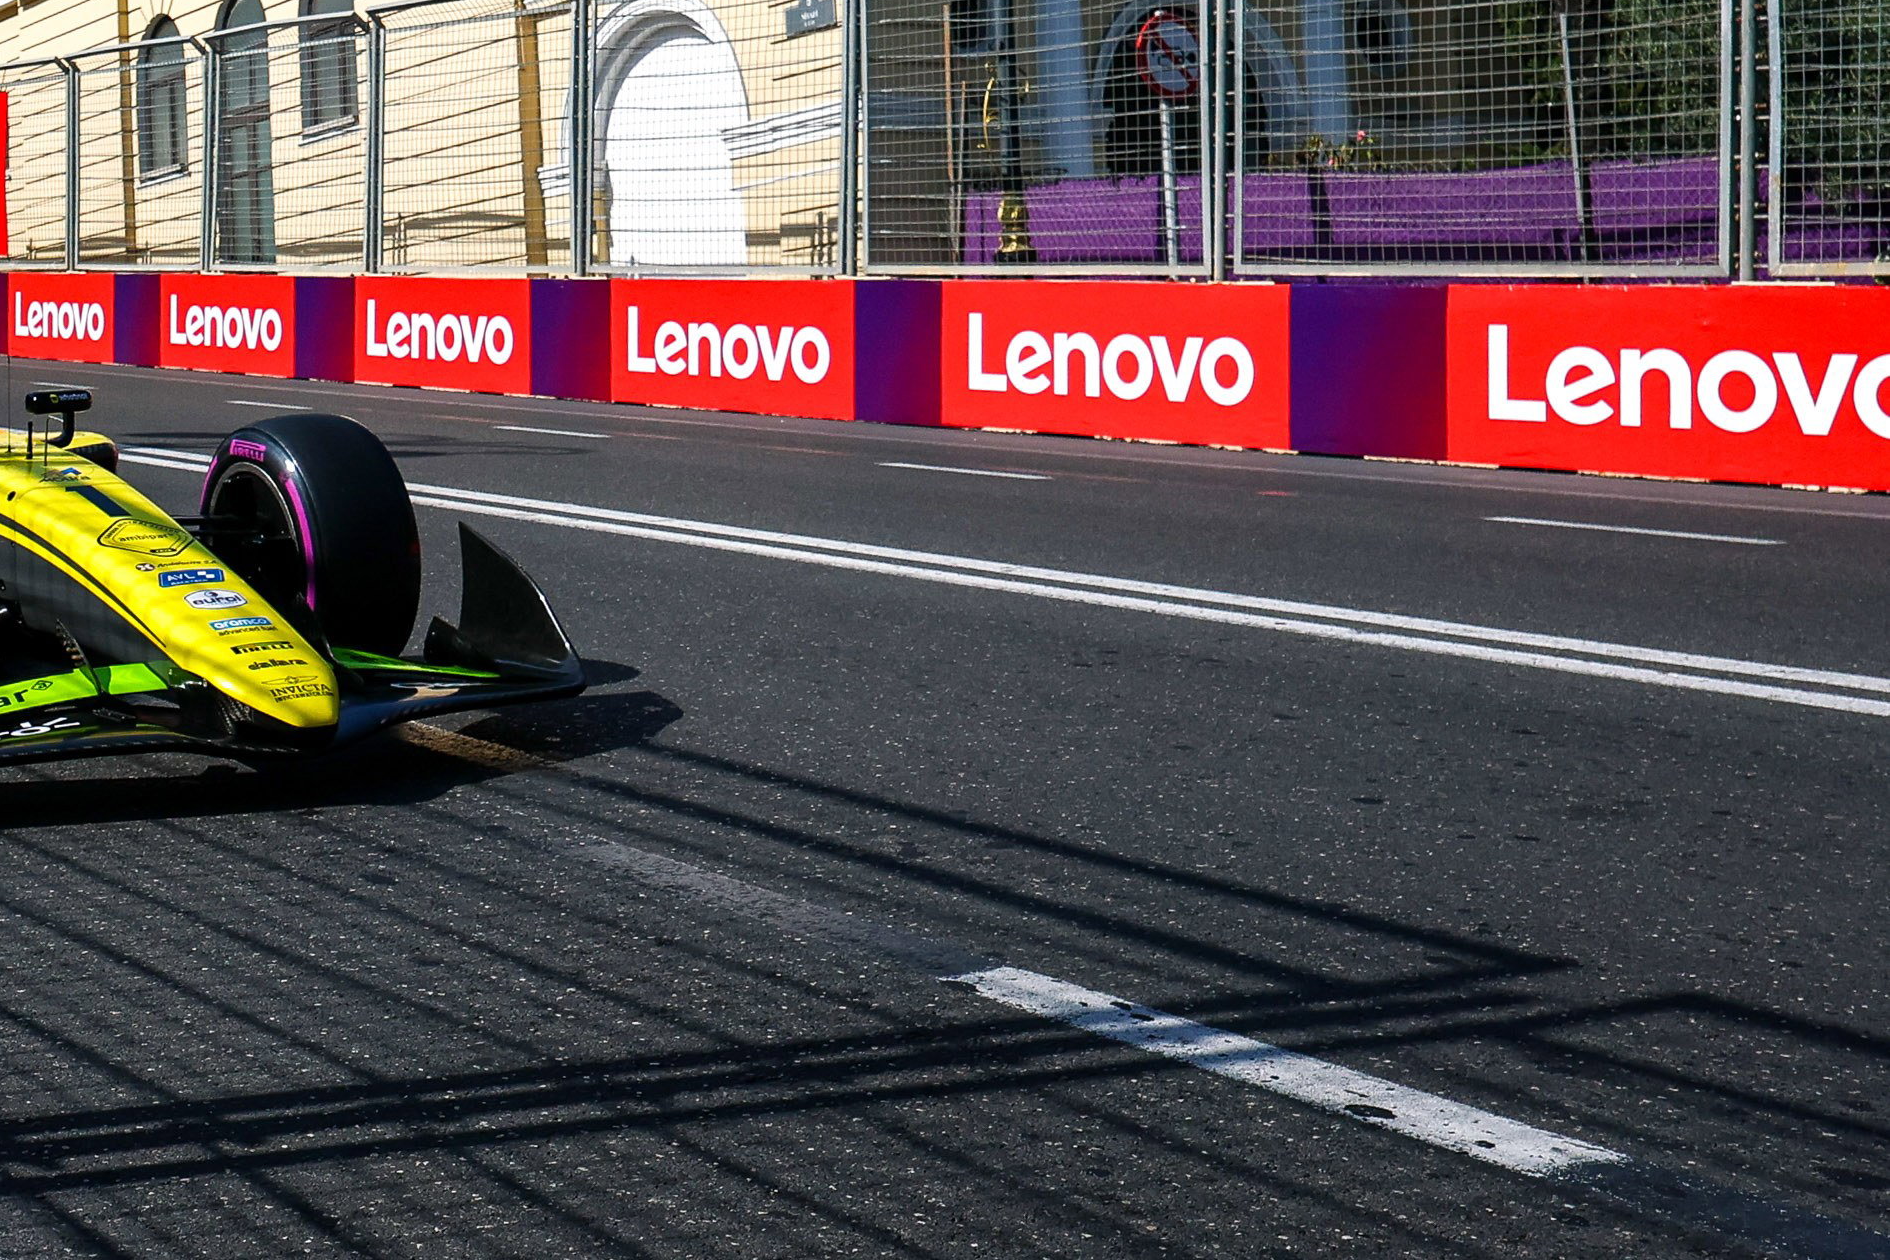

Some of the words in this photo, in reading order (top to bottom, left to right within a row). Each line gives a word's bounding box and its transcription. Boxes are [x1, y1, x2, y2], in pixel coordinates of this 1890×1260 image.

[15, 291, 105, 341] Lenovo
[170, 294, 283, 352] Lenovo
[366, 299, 514, 365] Lenovo
[627, 305, 831, 384] Lenovo
[968, 312, 1255, 407] Lenovo
[229, 438, 267, 462] PIRELLI
[119, 532, 172, 543] ambipar
[166, 573, 196, 582] AVL
[192, 594, 240, 606] eurol
[213, 617, 269, 629] aramco
[218, 627, 260, 636] advanced
[229, 641, 294, 655] PIRELLI
[248, 658, 309, 671] dallara
[269, 683, 333, 697] INVICTA
